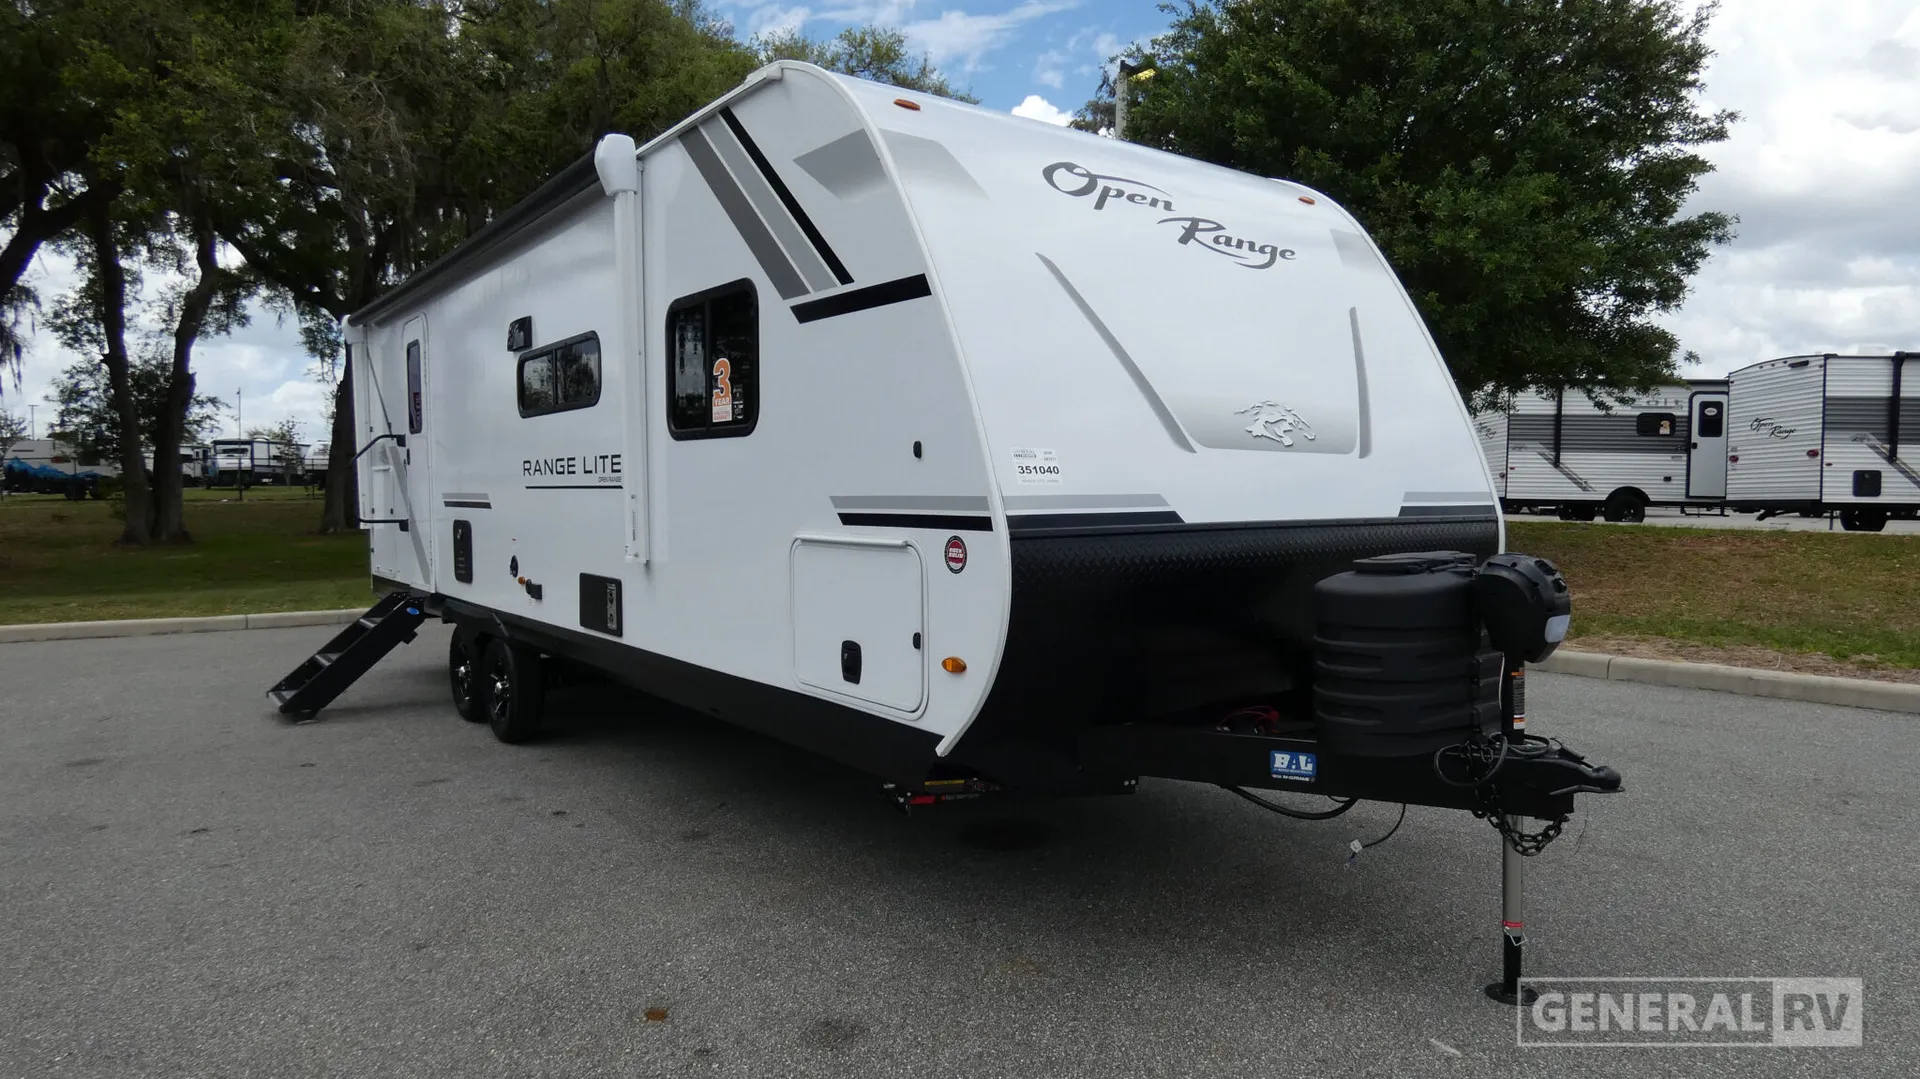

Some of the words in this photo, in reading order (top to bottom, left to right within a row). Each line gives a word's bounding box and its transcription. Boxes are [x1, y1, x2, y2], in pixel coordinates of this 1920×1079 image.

[1042, 161, 1176, 211] Open
[1156, 216, 1297, 270] Range
[713, 357, 731, 398] 3
[523, 457, 576, 476] RANGE
[583, 454, 622, 474] LITE
[1017, 465, 1060, 475] 351040
